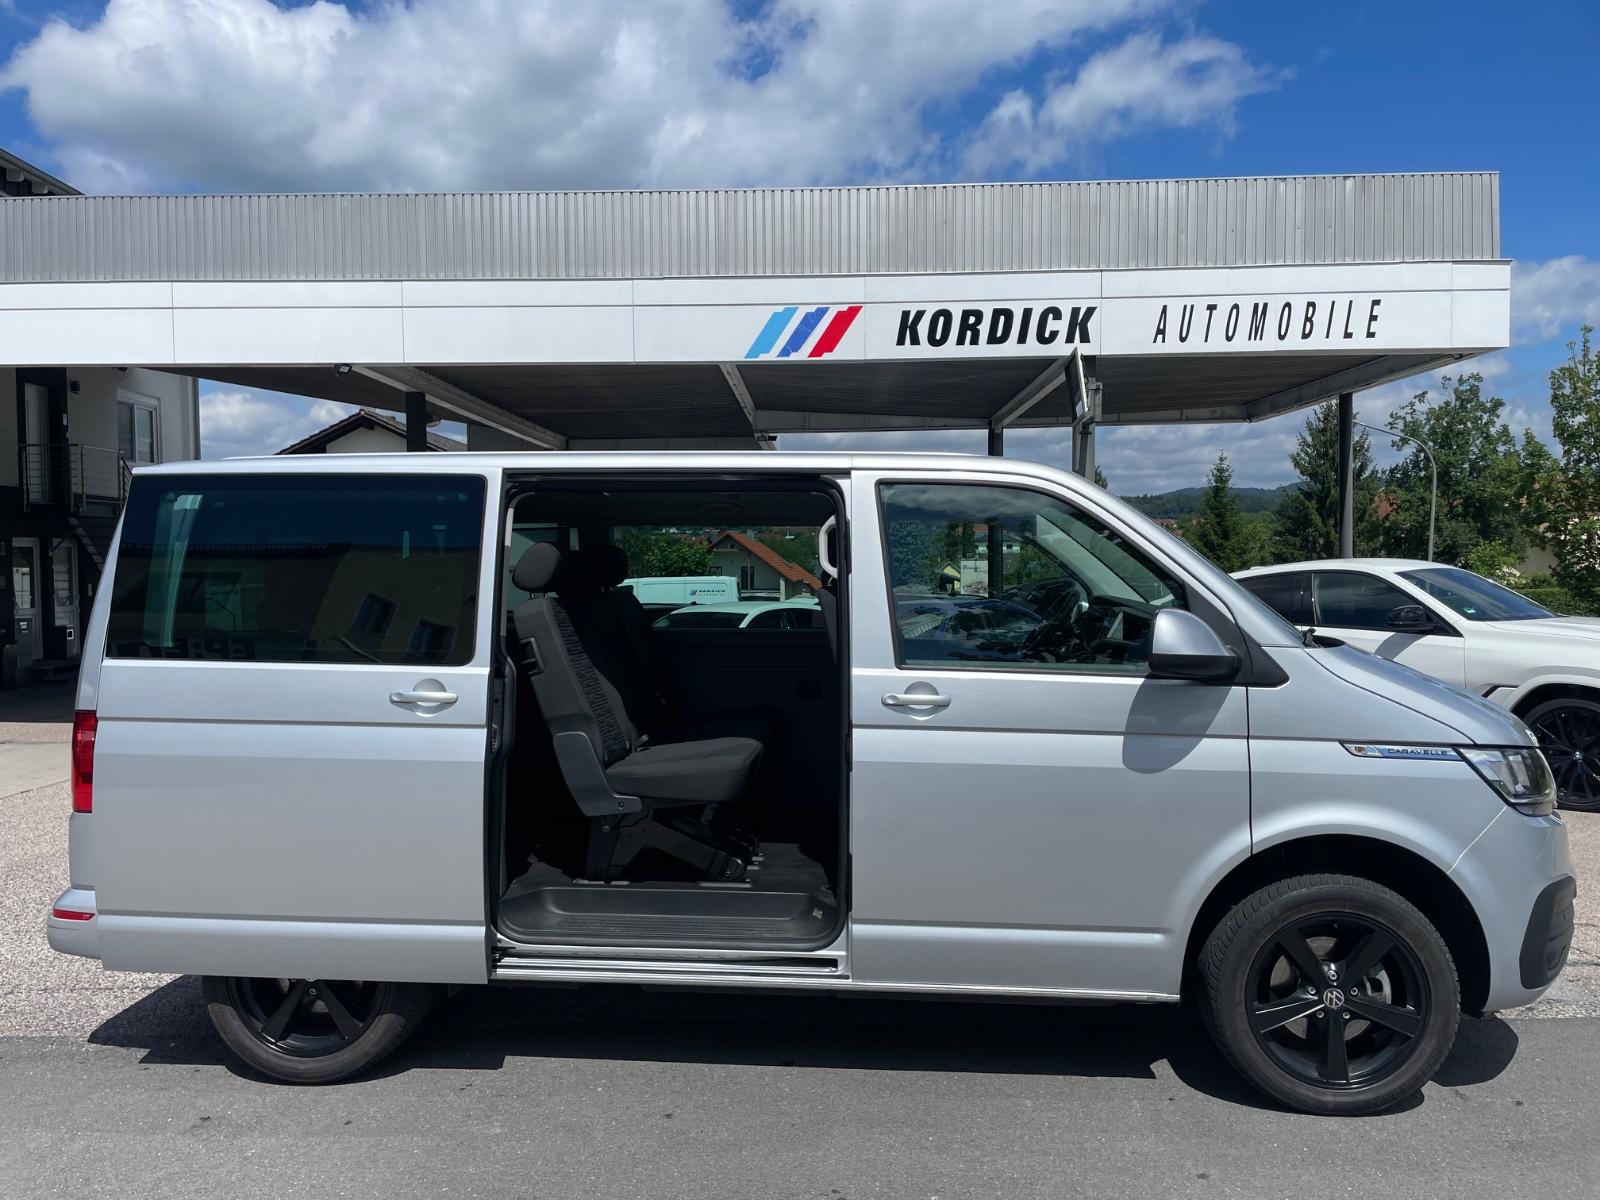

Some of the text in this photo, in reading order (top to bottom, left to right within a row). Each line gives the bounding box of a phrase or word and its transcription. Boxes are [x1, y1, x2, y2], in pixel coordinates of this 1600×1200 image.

[896, 299, 1381, 347] KORDICK AUTOMOBILE
[1387, 748, 1448, 756] CARAVELLE
